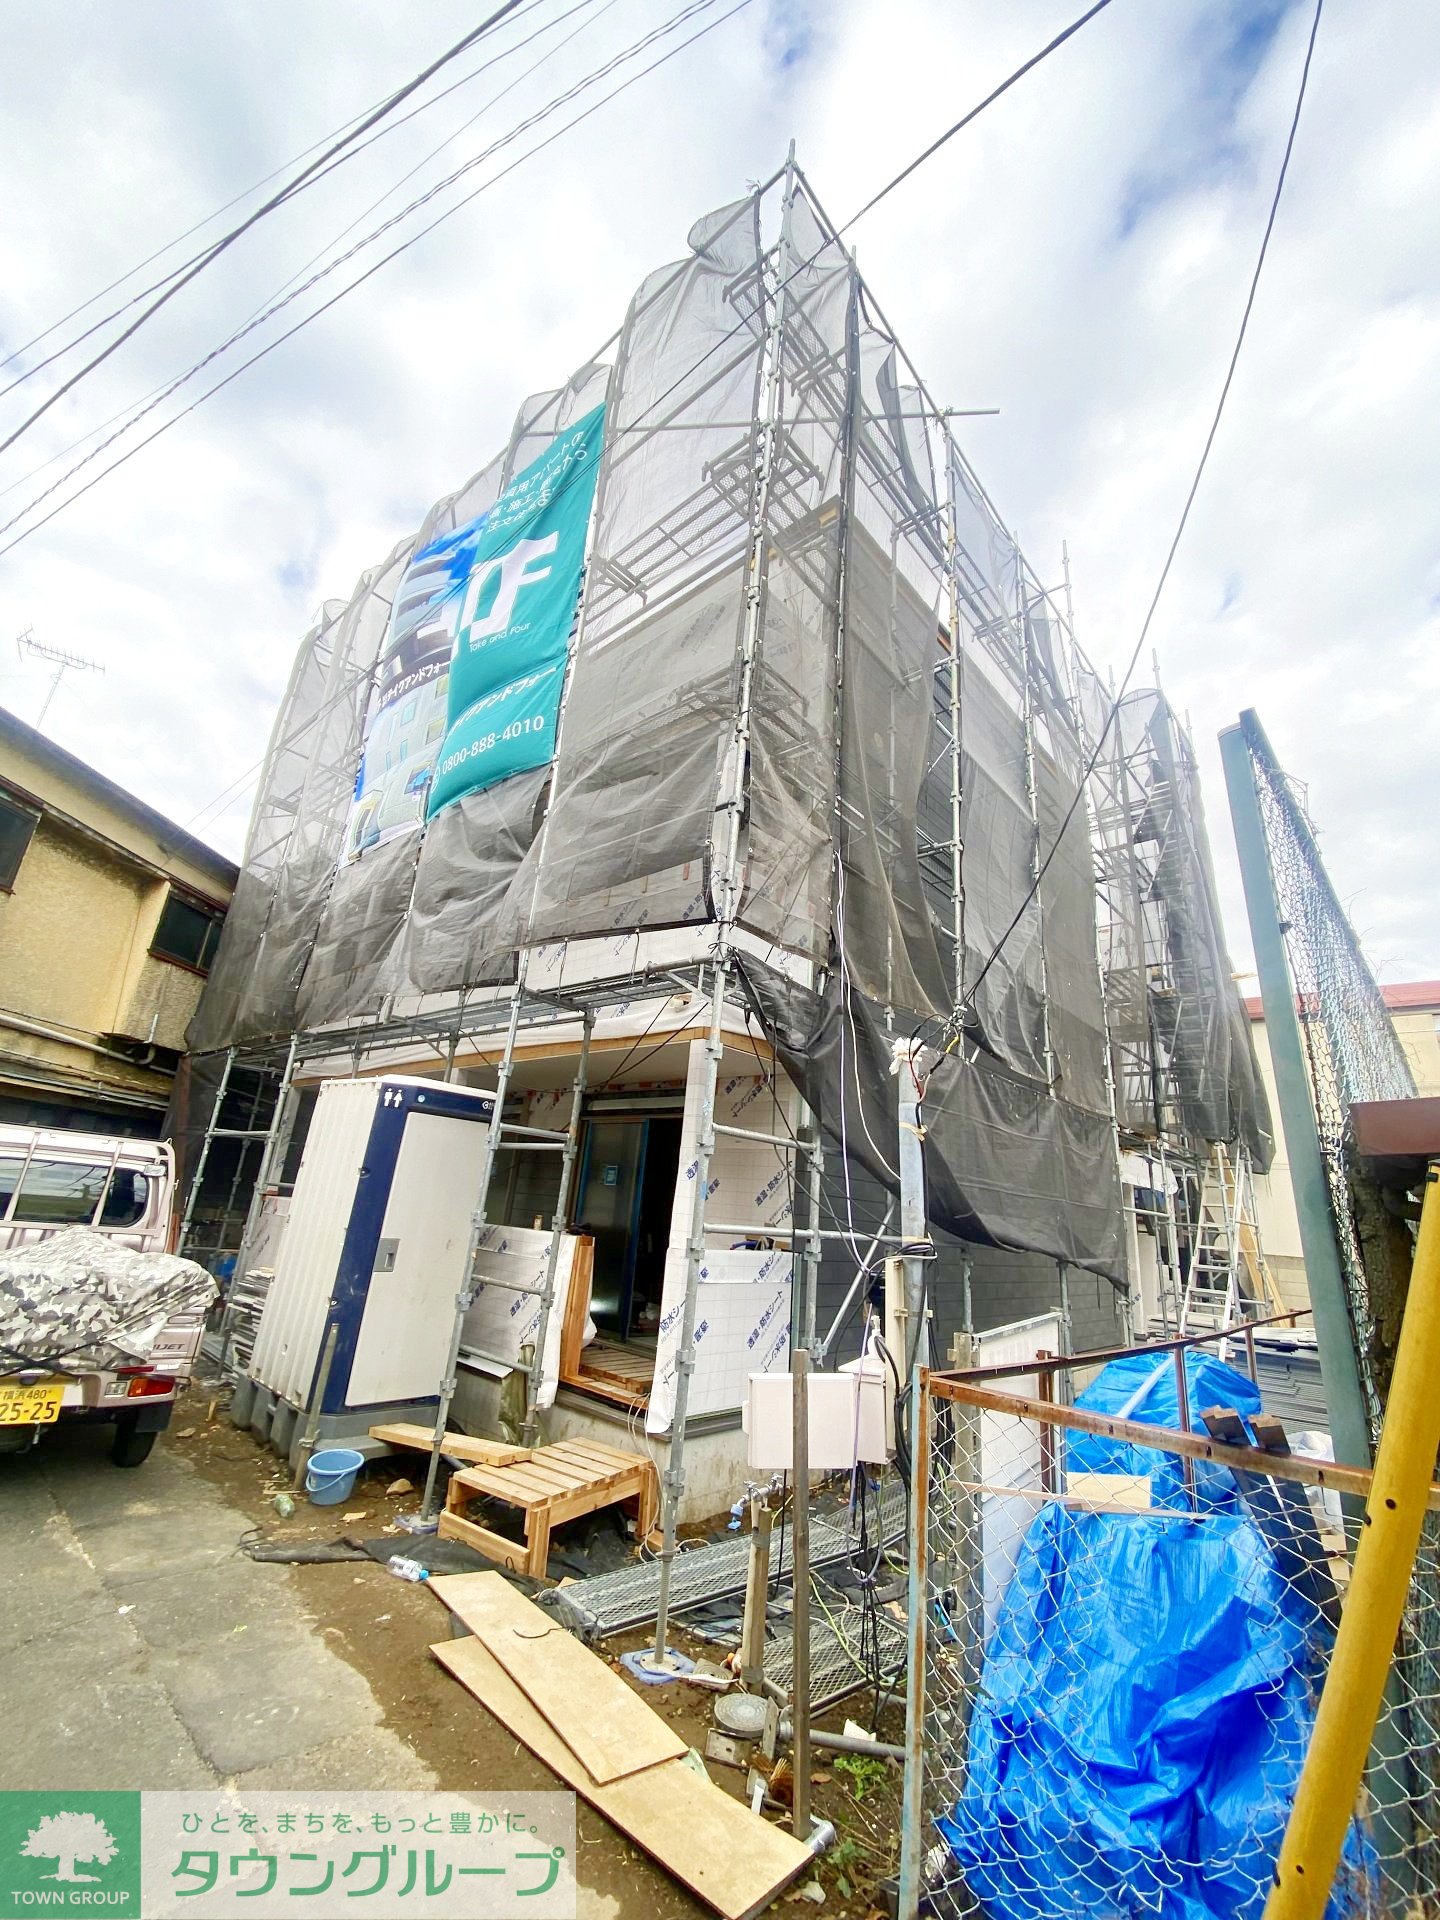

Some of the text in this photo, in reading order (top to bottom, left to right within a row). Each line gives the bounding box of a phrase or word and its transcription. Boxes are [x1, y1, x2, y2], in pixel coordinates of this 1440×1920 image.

[469, 640, 487, 653] Take
[489, 631, 507, 643] and
[442, 715, 545, 775] 0800-888-4010
